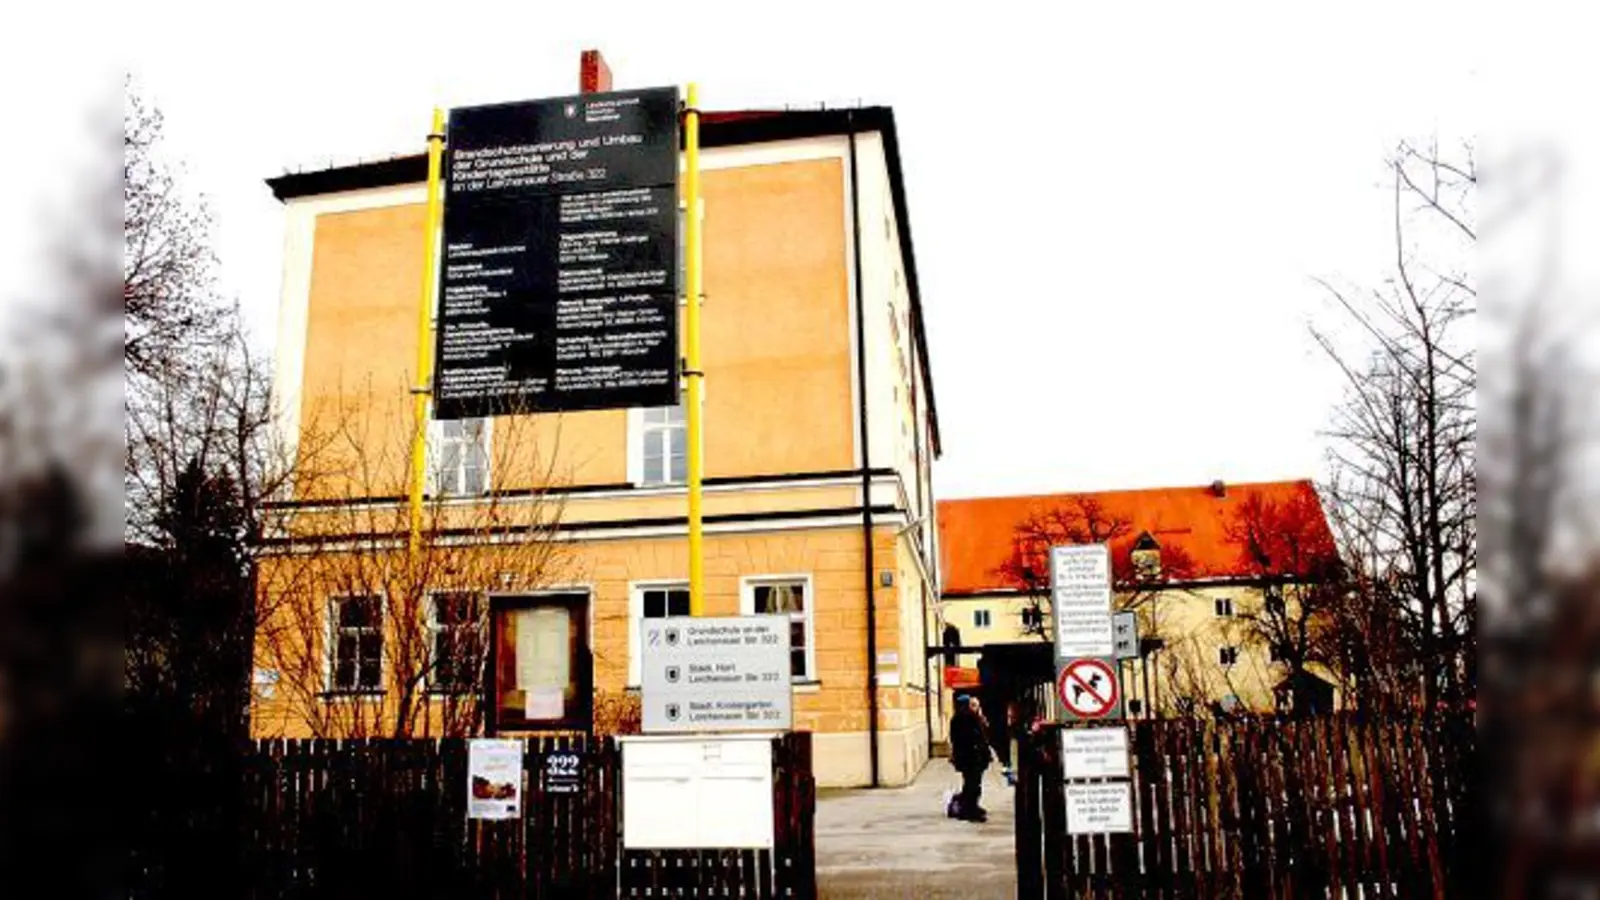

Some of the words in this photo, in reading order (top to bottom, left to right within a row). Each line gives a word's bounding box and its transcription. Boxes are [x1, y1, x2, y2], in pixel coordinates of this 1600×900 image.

[578, 138, 600, 149] und
[602, 134, 643, 146] Umbau
[452, 158, 473, 170] der
[474, 152, 543, 169] Grundschule
[545, 151, 568, 162] und
[570, 149, 589, 160] der
[452, 182, 466, 191] an
[468, 179, 486, 190] der
[687, 625, 741, 636] Grundschule
[546, 754, 580, 776] 322
